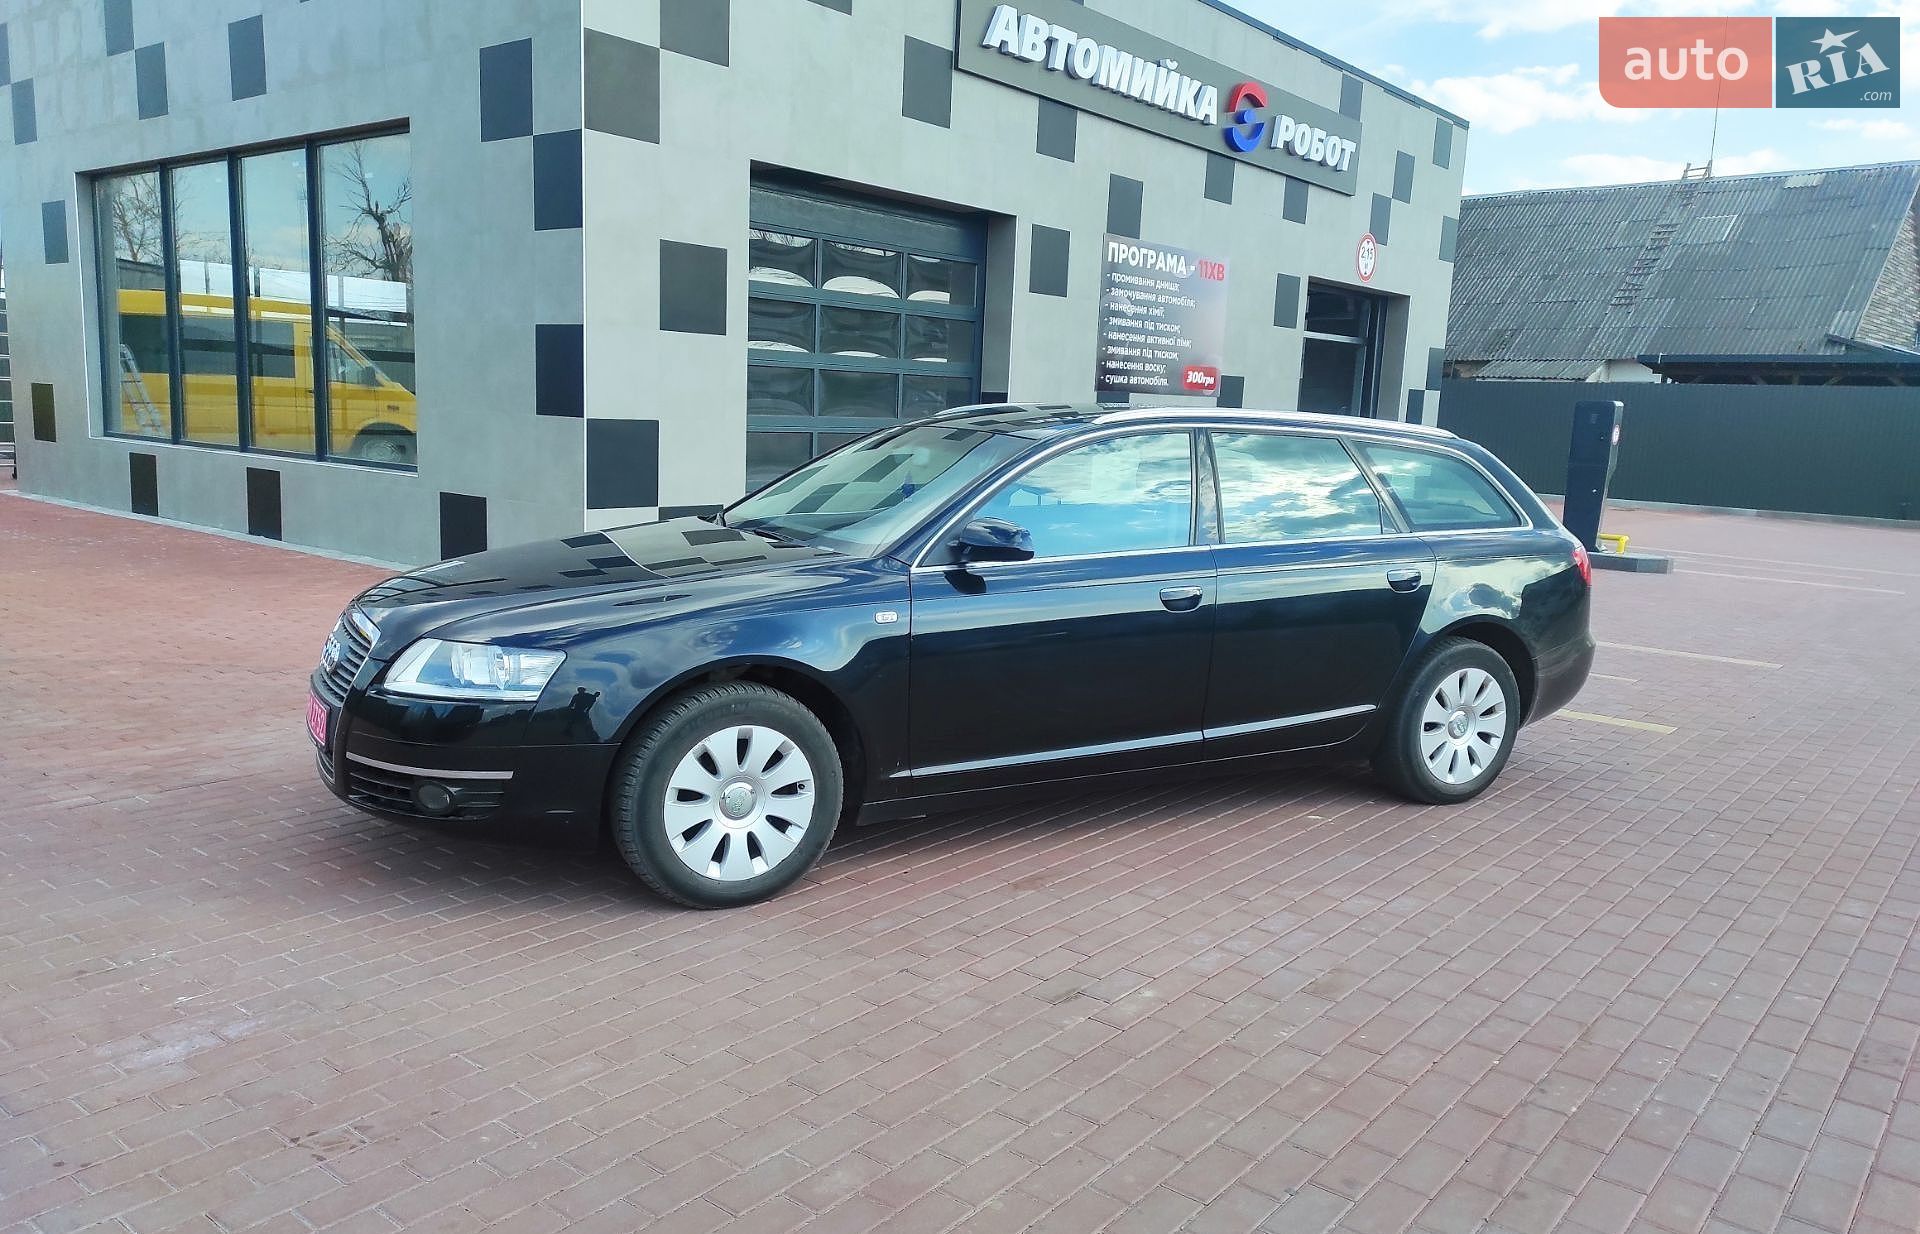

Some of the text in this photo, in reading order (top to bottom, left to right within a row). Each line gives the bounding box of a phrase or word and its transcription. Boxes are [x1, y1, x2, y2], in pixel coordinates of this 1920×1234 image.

[982, 4, 1357, 171] АВТОМИЙКА РОБОТ
[1108, 242, 1186, 274] ПРОГРАМА
[1112, 272, 1155, 287] промивання
[1110, 288, 1156, 302] замочування
[1110, 302, 1147, 314] нанесення
[1109, 317, 1142, 329] змивання
[1144, 319, 1155, 331] під
[1108, 331, 1145, 343] нанесення
[1107, 345, 1140, 357] змивання
[1142, 347, 1152, 359] під
[1106, 360, 1143, 371] нанесення
[1105, 374, 1128, 385] сушка
[1186, 371, 1215, 386] 300грн
